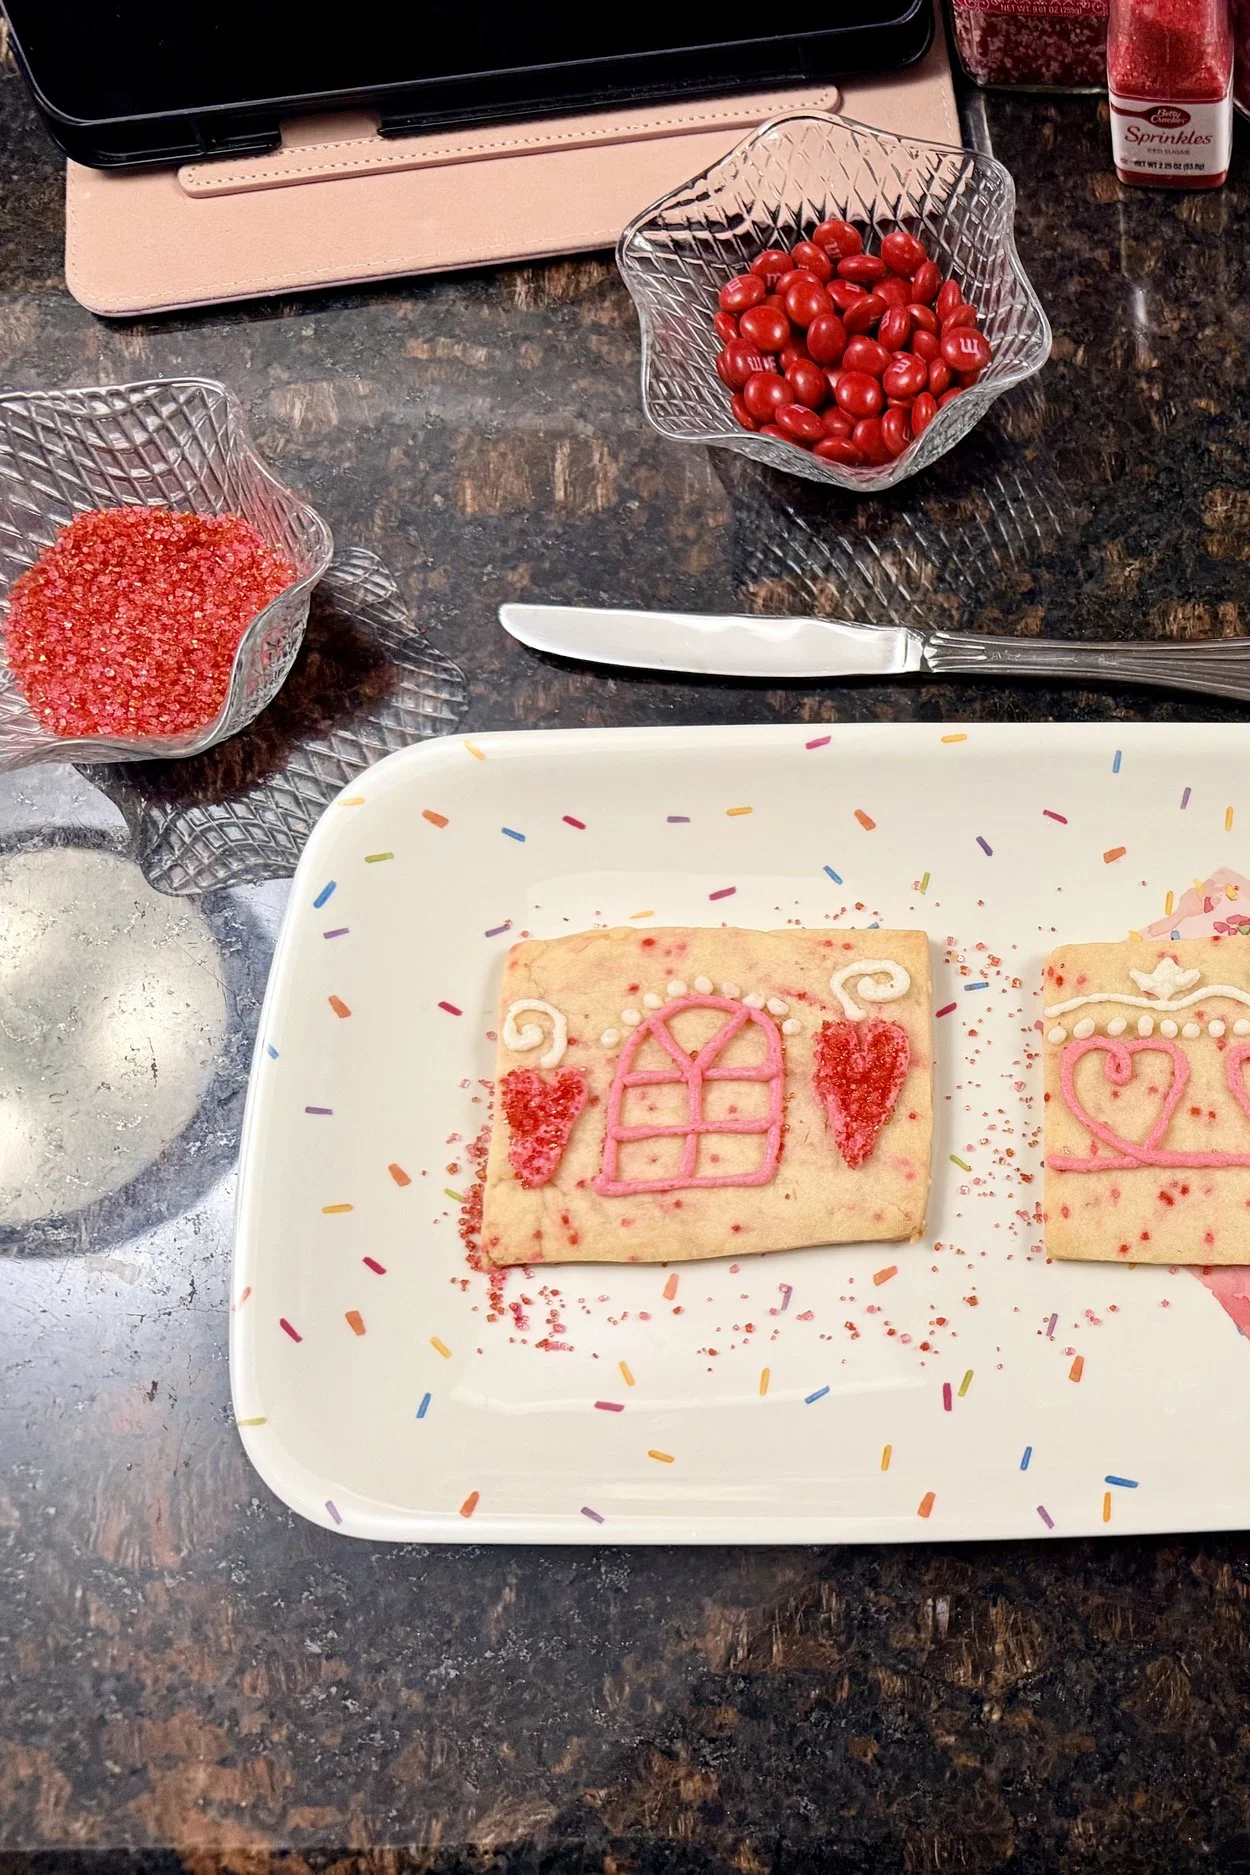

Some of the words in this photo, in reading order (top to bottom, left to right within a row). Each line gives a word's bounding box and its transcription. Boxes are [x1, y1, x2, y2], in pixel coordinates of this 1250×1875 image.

[1000, 4, 1015, 12] NET
[1048, 6, 1059, 14] OZ
[1157, 108, 1181, 119] Betty
[1150, 114, 1186, 124] Crocker
[1124, 126, 1213, 146] Sprinkles
